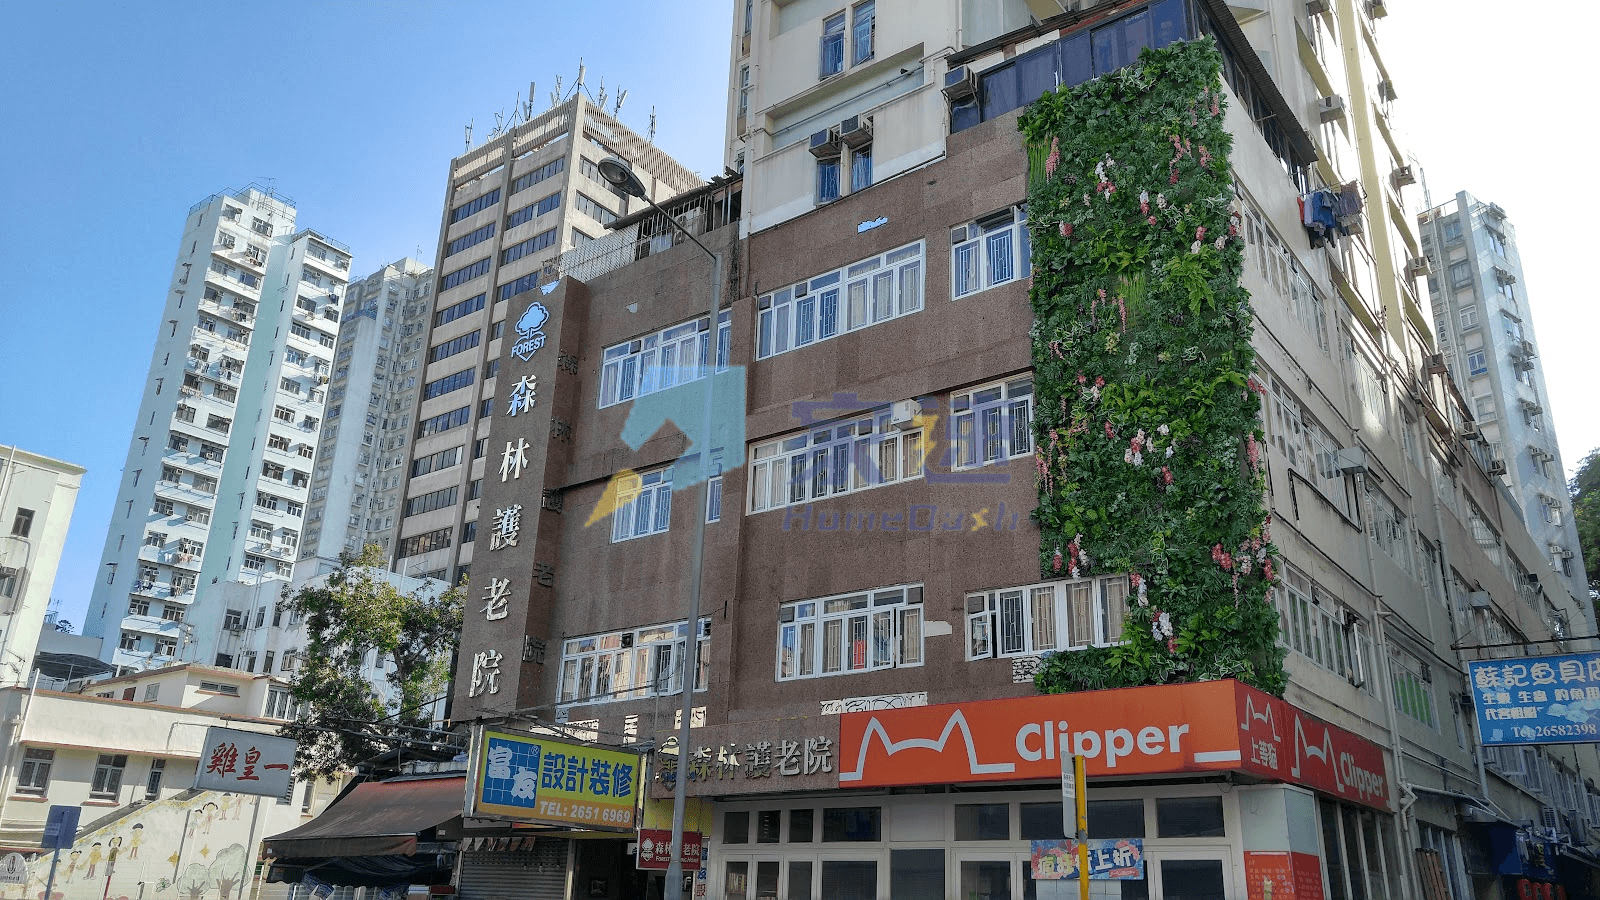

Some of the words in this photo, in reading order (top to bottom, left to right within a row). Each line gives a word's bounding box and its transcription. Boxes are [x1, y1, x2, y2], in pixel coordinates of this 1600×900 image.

[511, 335, 546, 358] FOREST
[468, 374, 538, 699] 森林護老院
[689, 735, 833, 781] 森林護老院
[1015, 720, 1190, 768] Clipper
[541, 751, 634, 798] 設計裝修
[1340, 751, 1384, 801] Clipper
[539, 801, 568, 817] TEL:
[570, 804, 599, 821] 2651
[602, 808, 631, 824] 6969
[655, 841, 700, 856] 森林老院
